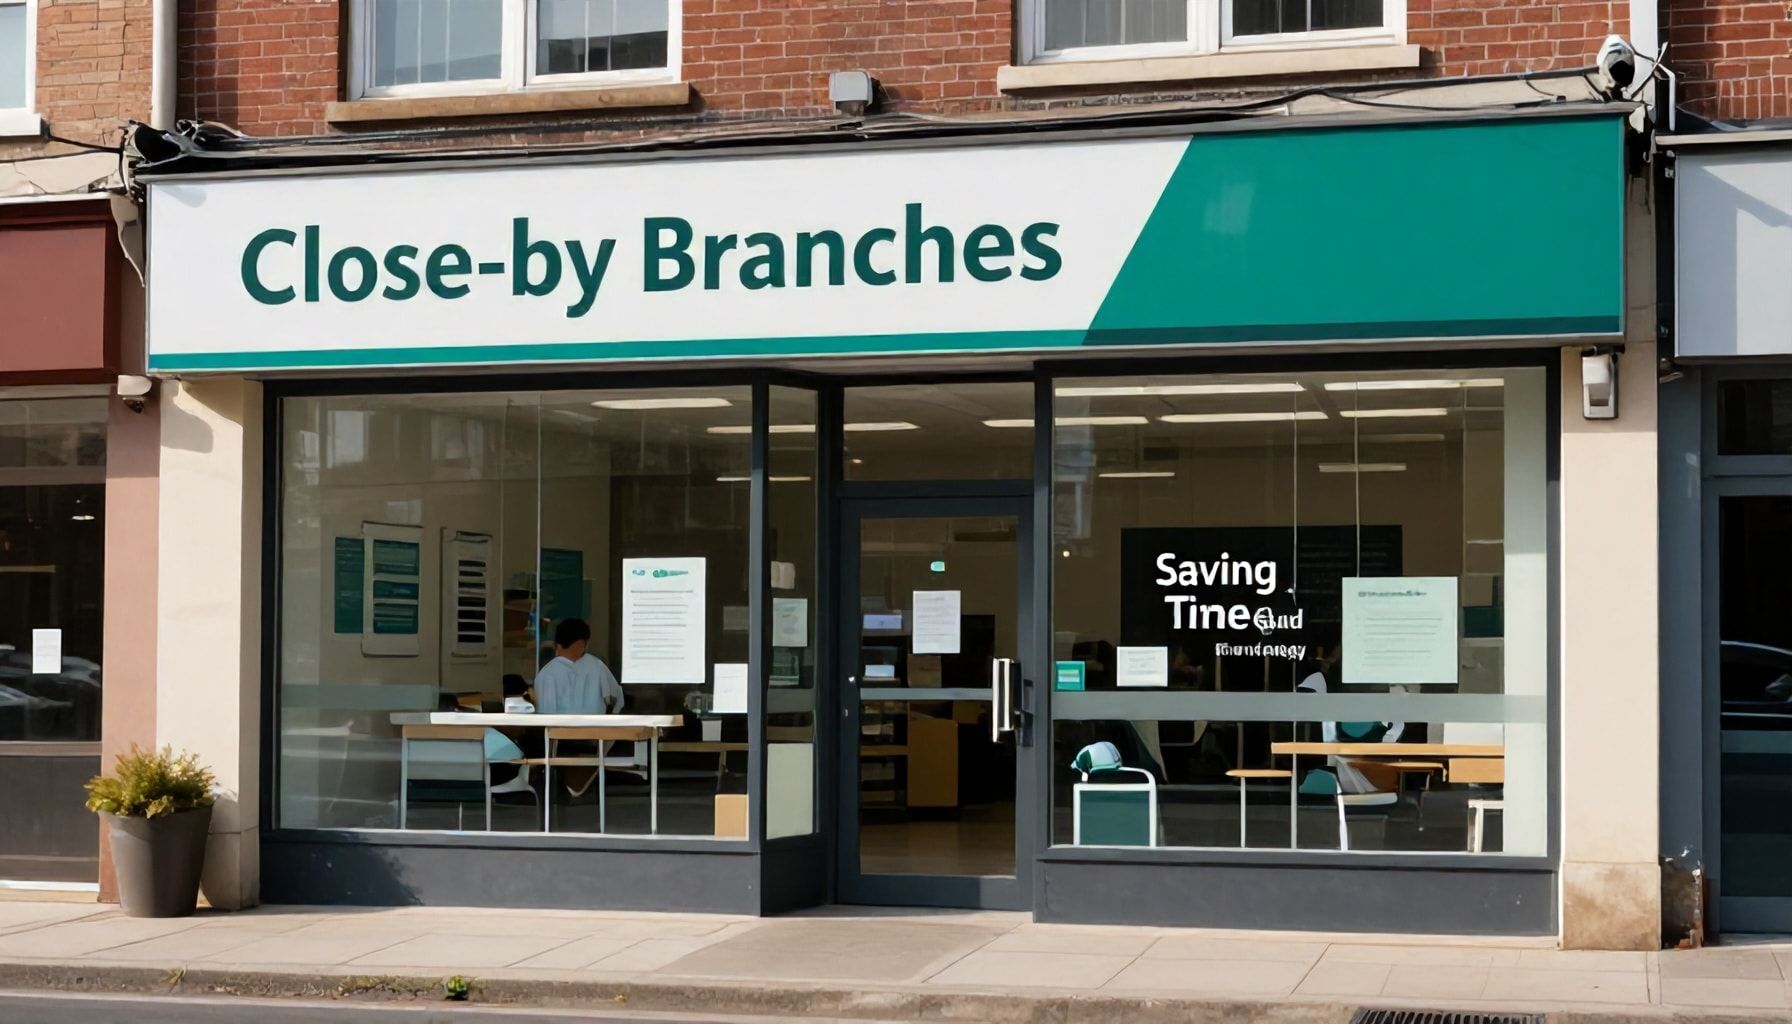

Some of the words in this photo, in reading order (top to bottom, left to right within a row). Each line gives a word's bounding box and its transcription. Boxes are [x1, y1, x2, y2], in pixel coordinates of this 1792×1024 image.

[241, 217, 616, 318] Close-by
[644, 203, 1062, 292] Branches
[1156, 552, 1276, 596] Saving
